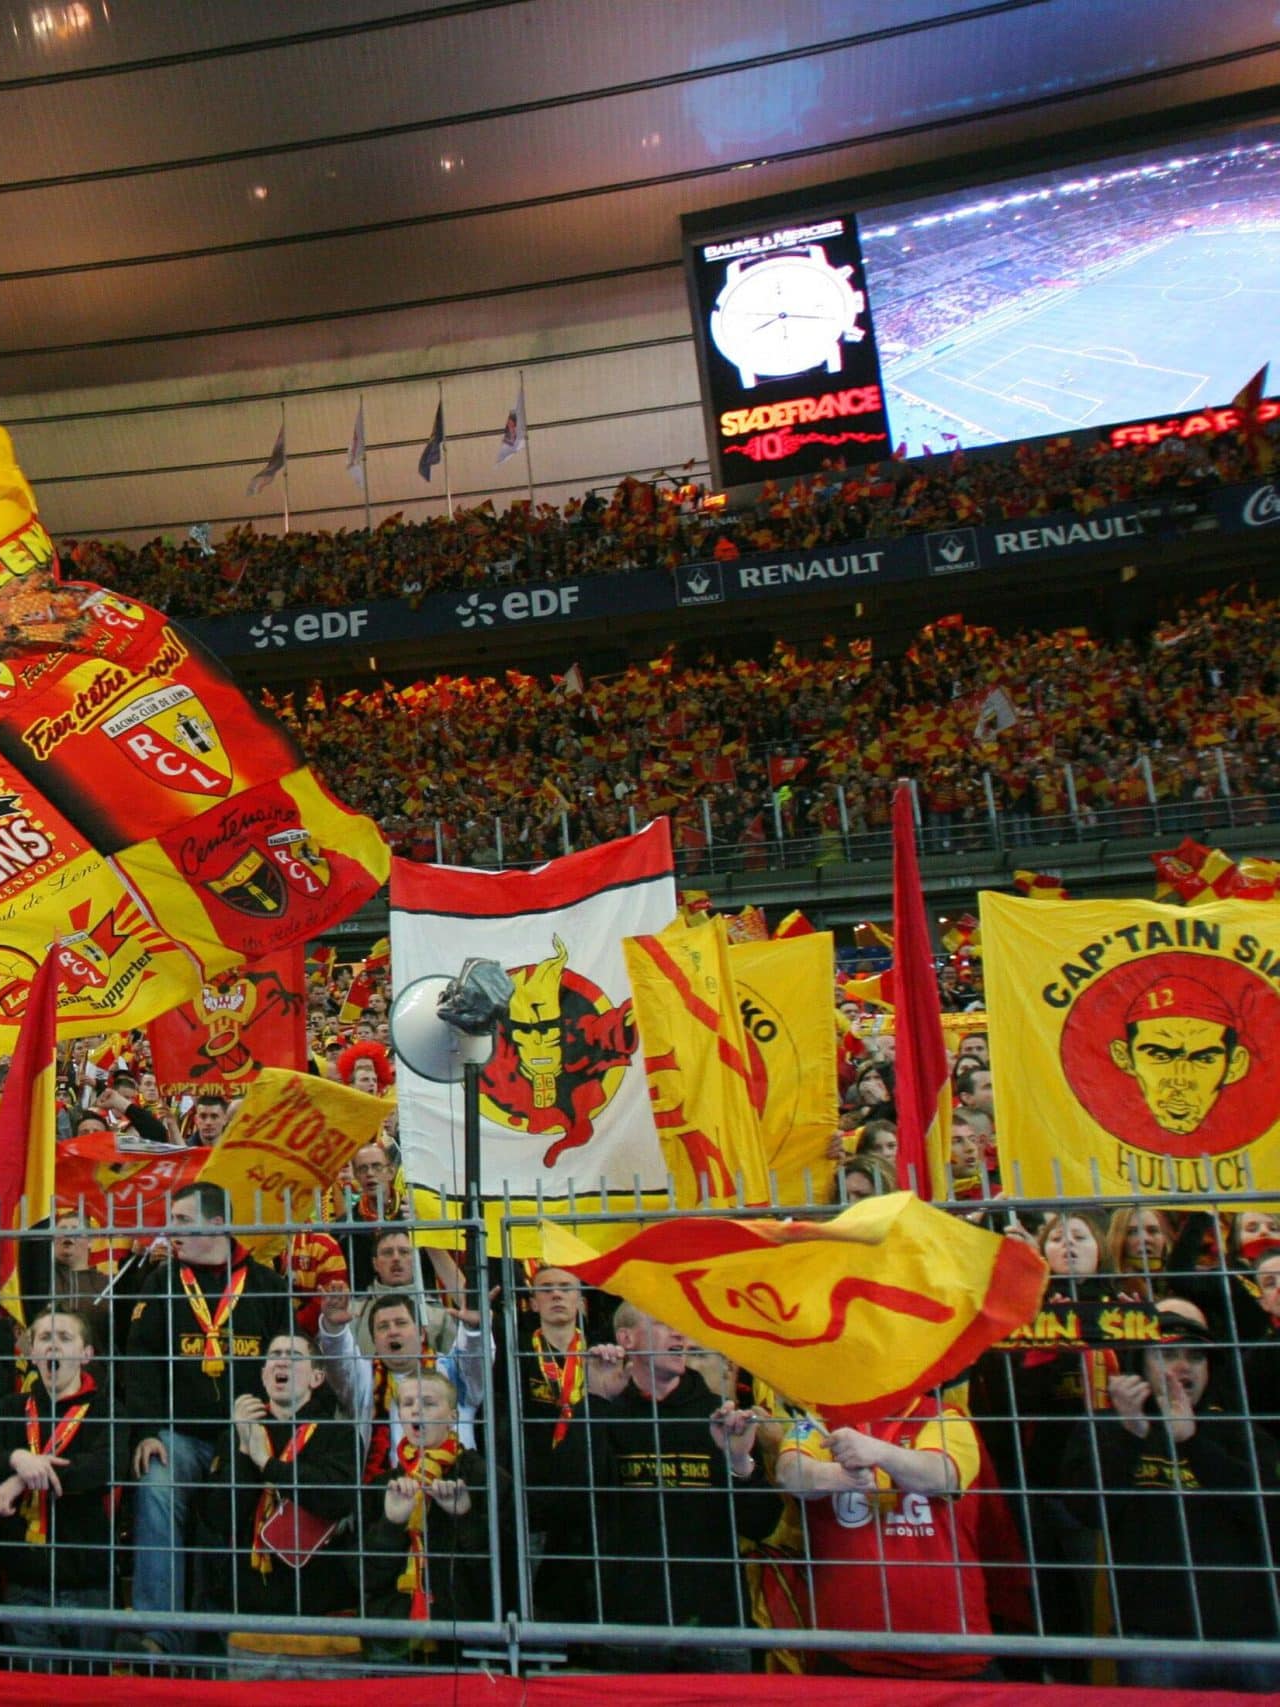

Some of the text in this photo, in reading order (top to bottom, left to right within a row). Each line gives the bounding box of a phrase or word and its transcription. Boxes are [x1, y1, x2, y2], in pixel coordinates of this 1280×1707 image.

[704, 237, 760, 258] BAUME
[739, 552, 885, 588] RENAULT
[109, 712, 140, 735] RACING
[140, 703, 159, 717] CLUB
[159, 696, 170, 707] DE
[169, 687, 190, 703] LENS
[127, 733, 220, 789] RCL
[23, 895, 43, 911] de
[48, 860, 101, 890] Lens
[275, 850, 318, 893] RCL
[339, 921, 359, 933] 122
[59, 952, 102, 985] RCL
[1041, 919, 1220, 1009] CAP'TAIN
[1146, 989, 1174, 1009] 12
